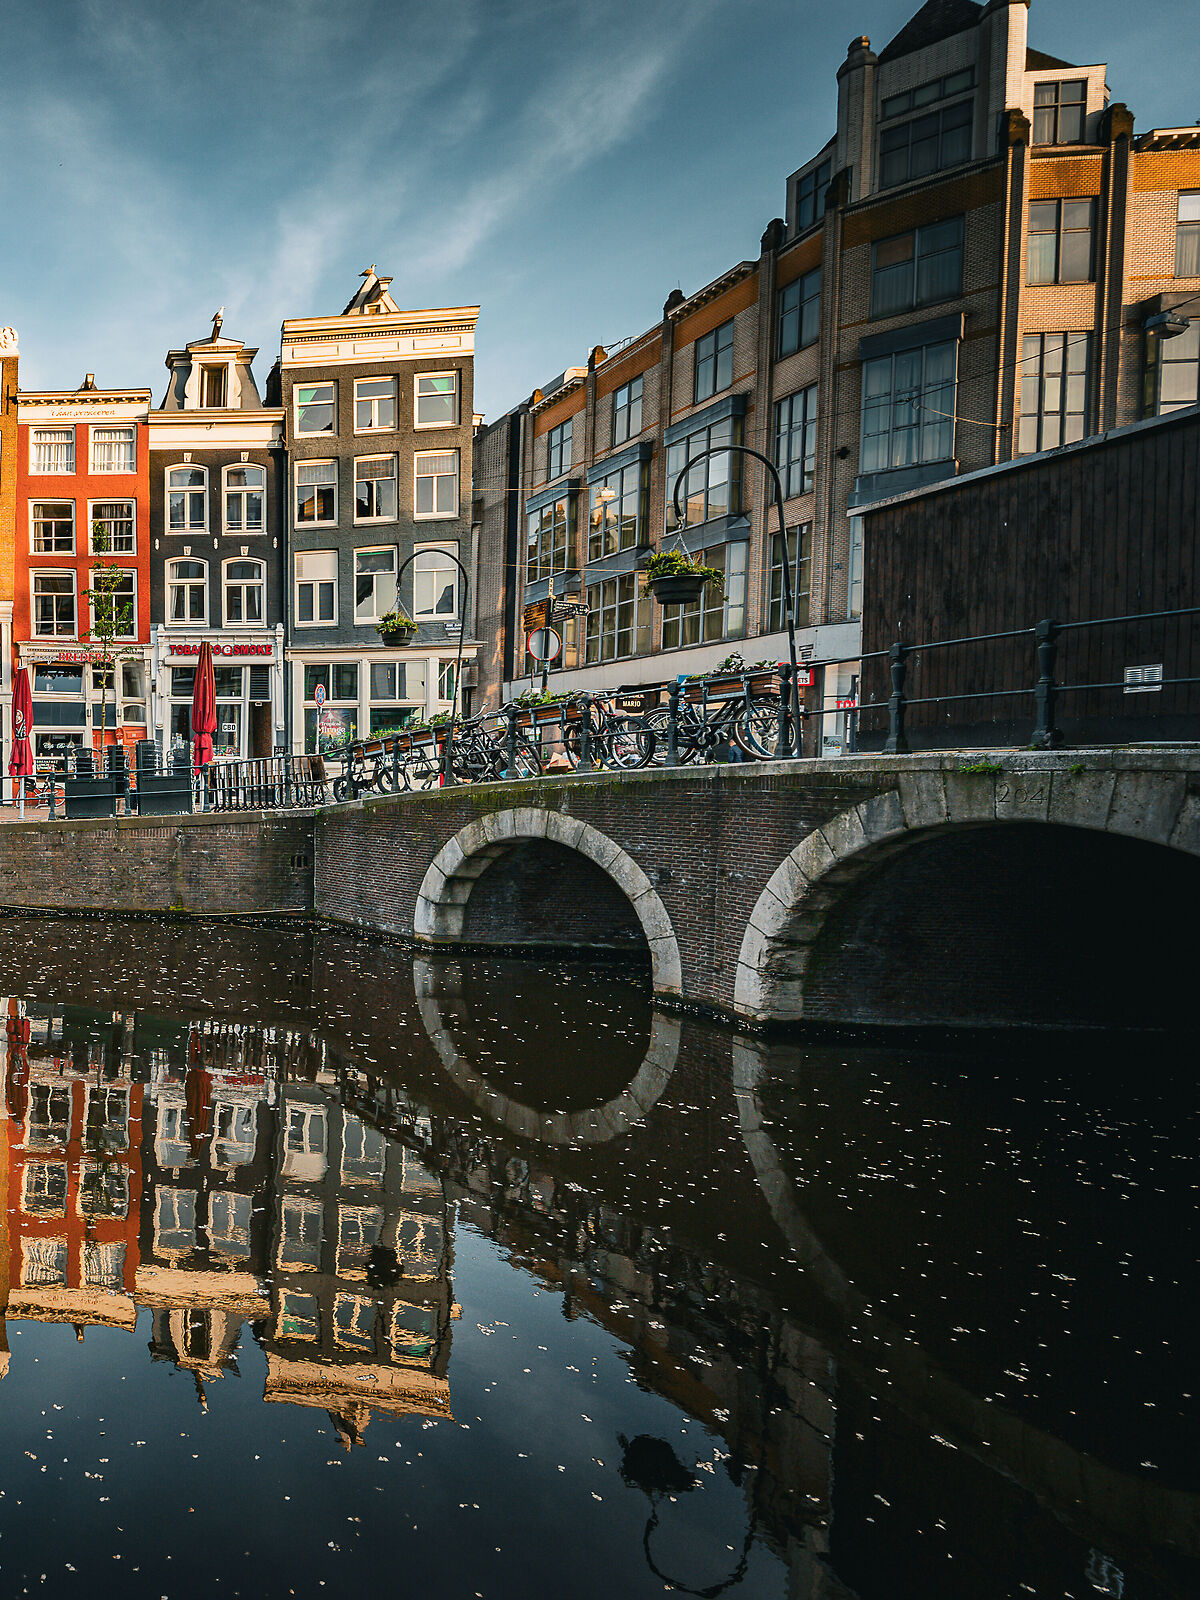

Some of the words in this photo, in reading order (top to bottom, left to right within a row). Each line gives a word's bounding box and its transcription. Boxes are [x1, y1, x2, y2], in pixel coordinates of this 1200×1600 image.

[169, 645, 221, 656] TOBAO
[234, 645, 272, 655] SMOKE
[58, 652, 112, 662] BREDERO
[622, 700, 641, 708] MARJO
[998, 781, 1048, 805] 204
